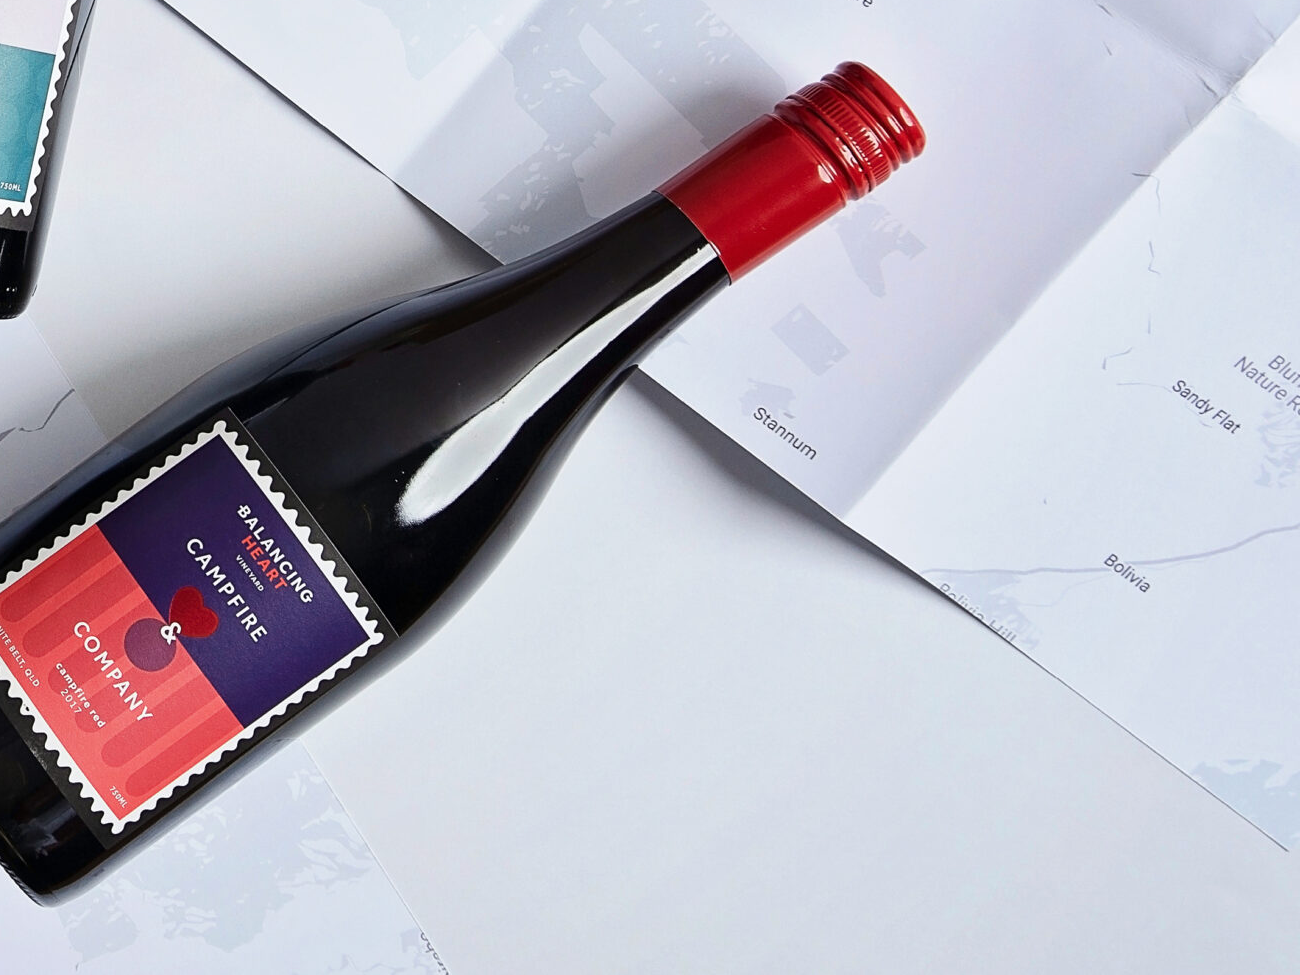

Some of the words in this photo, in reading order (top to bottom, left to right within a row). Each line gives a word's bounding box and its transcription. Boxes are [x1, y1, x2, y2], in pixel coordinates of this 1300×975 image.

[0, 181, 22, 193] 750ML
[1233, 355, 1288, 401] Nature
[1171, 379, 1215, 415] Sandy
[1212, 409, 1242, 435] Flat
[752, 407, 818, 461] Stannum
[235, 553, 264, 593] VINEYARD
[236, 503, 314, 605] BALANCING
[240, 535, 288, 592] HEART
[1103, 553, 1151, 593] Bolivia
[185, 537, 268, 645] CAMPFIRE
[8, 644, 26, 669] BELT,
[24, 668, 40, 687] QLD
[72, 620, 154, 723] COMPANY
[54, 661, 92, 709] campfire
[88, 708, 106, 729] red
[60, 688, 82, 715] 2017
[109, 785, 128, 809] 750ML
